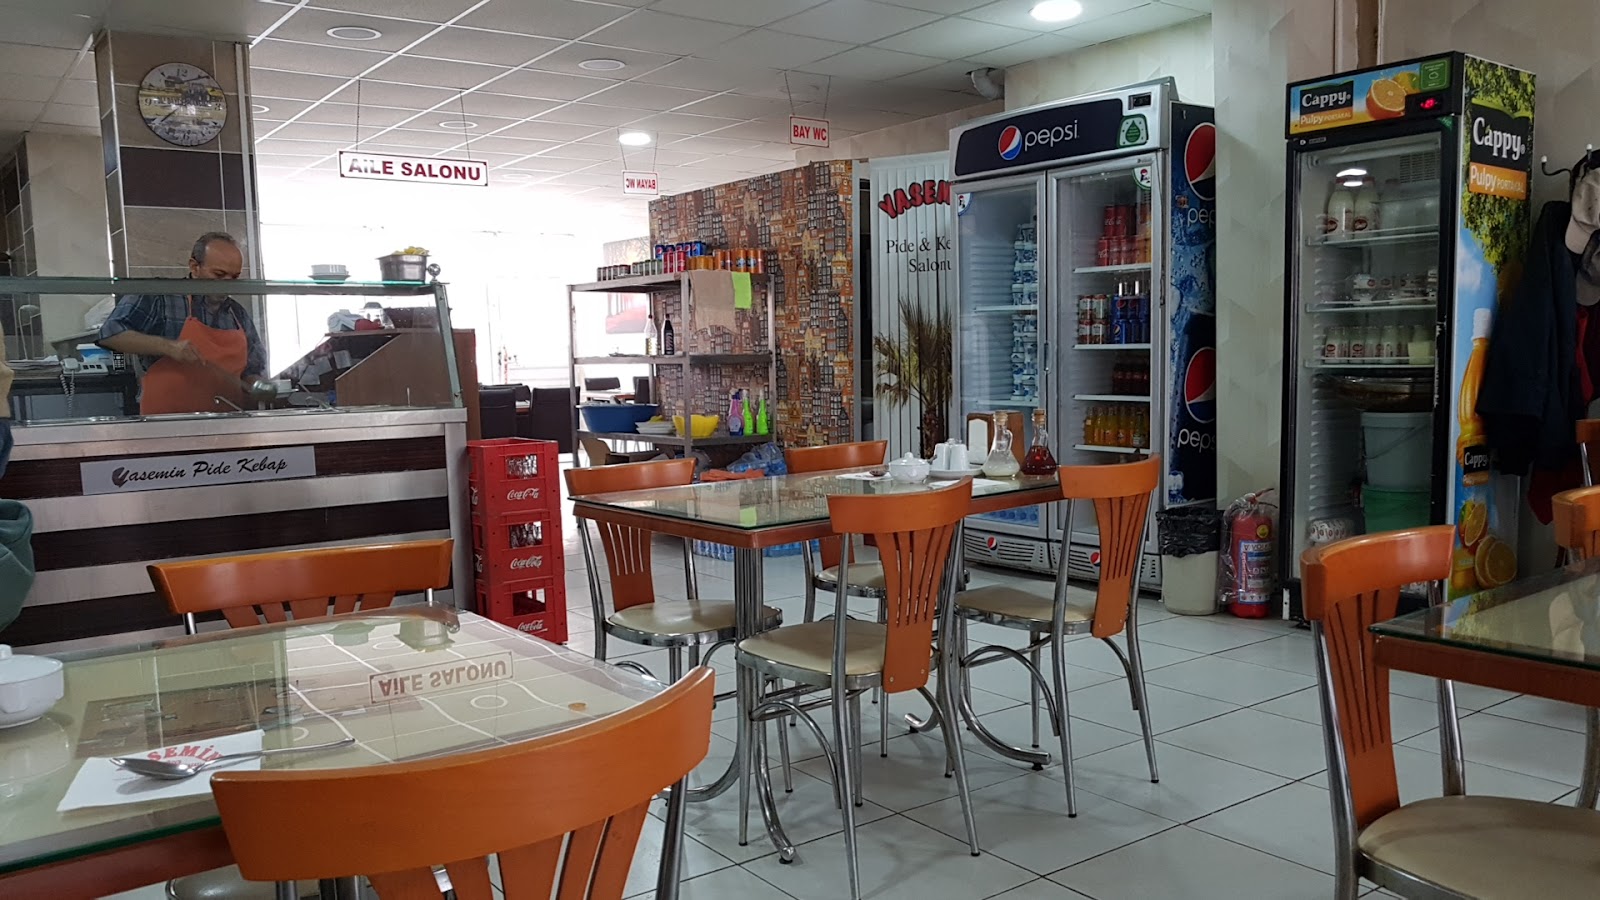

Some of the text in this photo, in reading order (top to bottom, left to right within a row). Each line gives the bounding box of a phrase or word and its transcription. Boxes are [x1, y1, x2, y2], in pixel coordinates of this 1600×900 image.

[1301, 92, 1347, 108] Cappy
[793, 124, 827, 141] BAY WC
[1025, 119, 1079, 151] pepsi
[1473, 116, 1523, 161] Cappy
[401, 162, 481, 181] SALONU
[1470, 165, 1497, 192] Pulpy
[886, 239, 915, 254] Pide
[919, 237, 931, 252] &
[112, 456, 288, 488] Yasemin Pide Kebap
